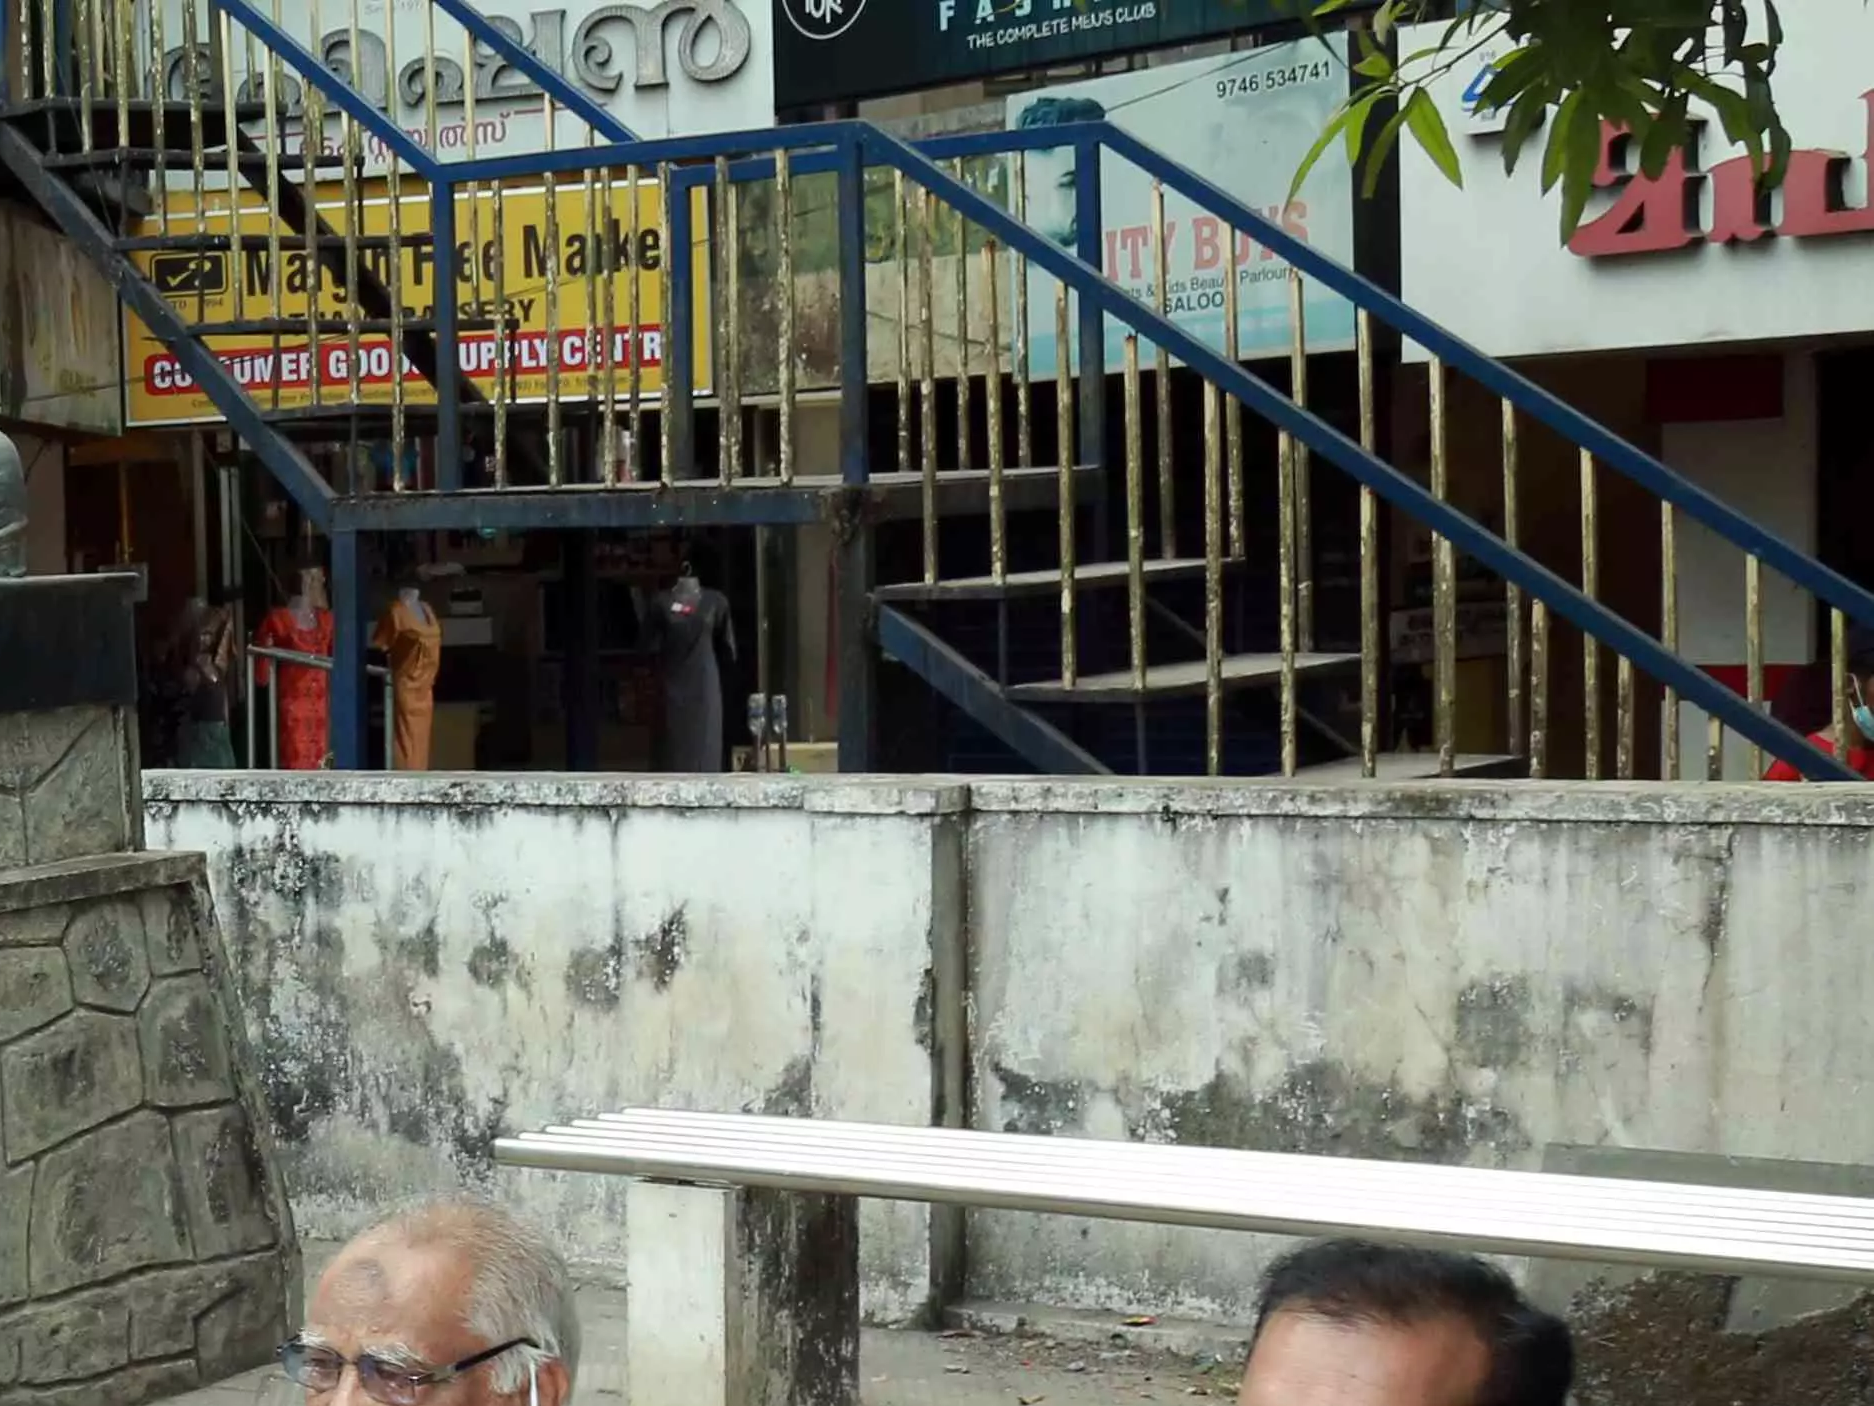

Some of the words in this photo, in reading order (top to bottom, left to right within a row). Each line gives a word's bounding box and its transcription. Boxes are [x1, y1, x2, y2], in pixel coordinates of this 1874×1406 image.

[966, 33, 996, 50] THE
[996, 18, 1070, 46] COMPLETE
[1114, 2, 1157, 23] CLUB
[1216, 74, 1260, 99] 9746
[1265, 59, 1332, 91] 534741
[1104, 216, 1177, 282] ITY
